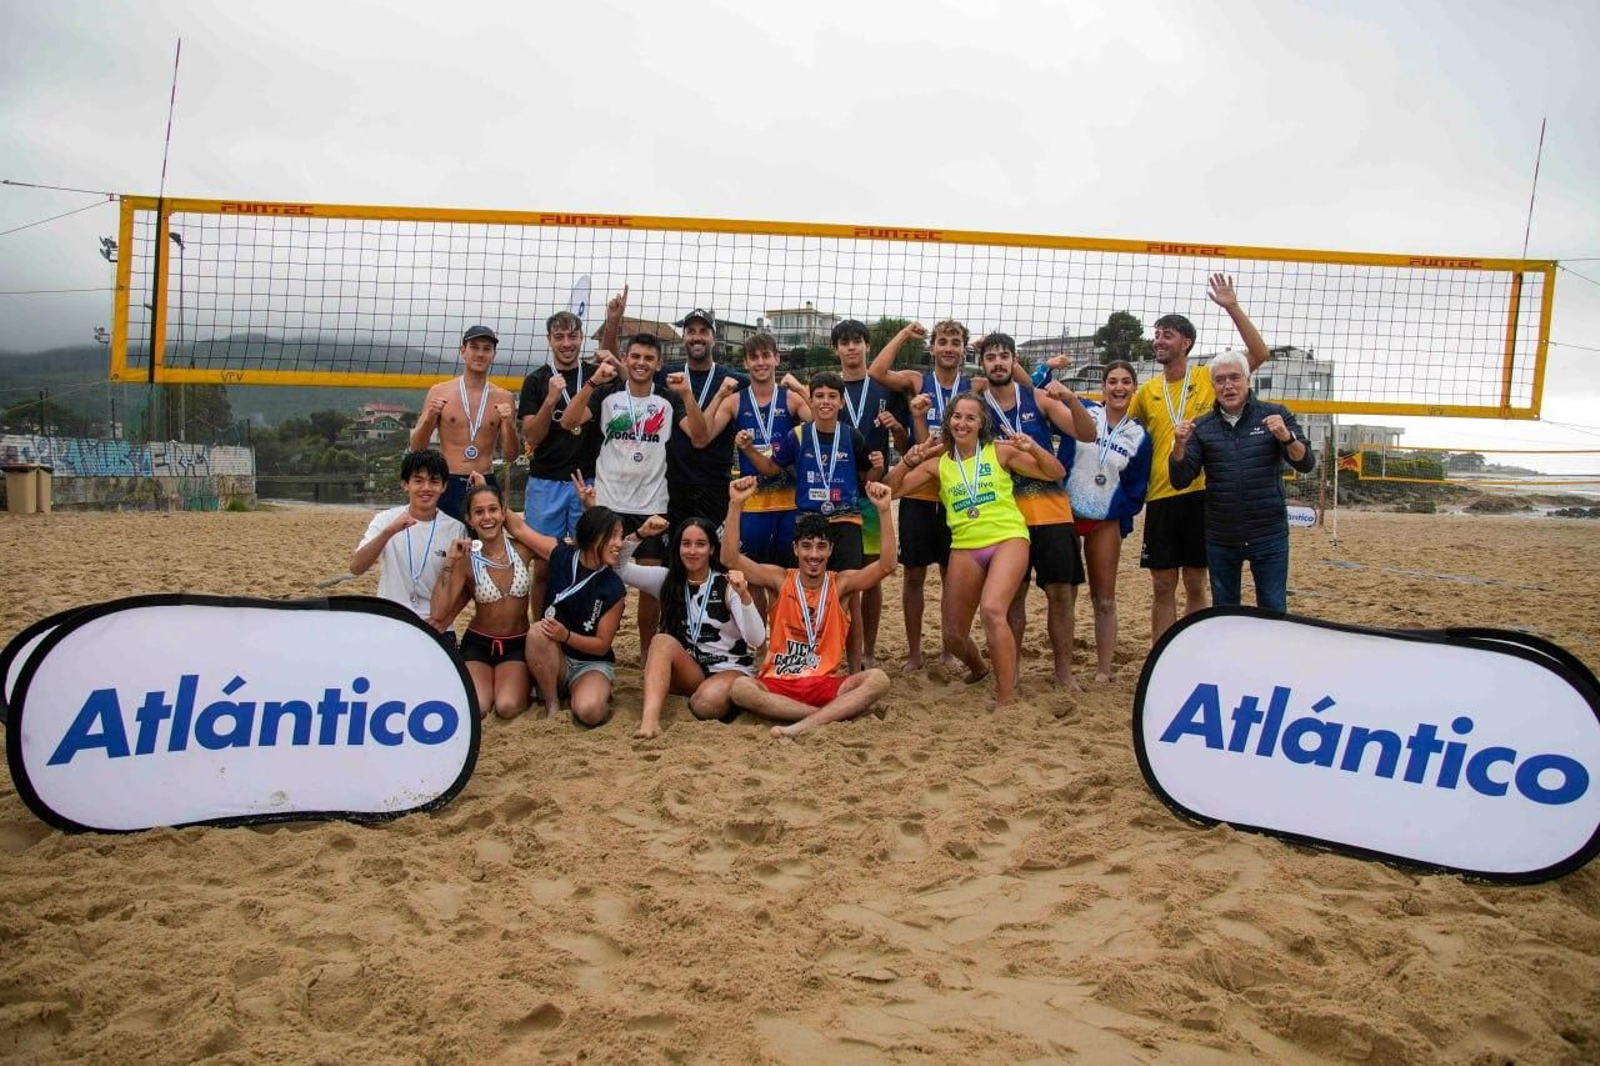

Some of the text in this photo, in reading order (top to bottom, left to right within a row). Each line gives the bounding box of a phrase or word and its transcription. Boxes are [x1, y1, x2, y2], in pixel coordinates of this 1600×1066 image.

[220, 202, 314, 215] FUNTEC
[540, 214, 633, 226] FUNTEC
[854, 228, 942, 241] FUNTEC
[1146, 243, 1226, 256] FUNTEC
[1410, 257, 1481, 269] FUNTEC
[46, 674, 459, 766] Atlántico
[1159, 682, 1590, 806] Atlántico
